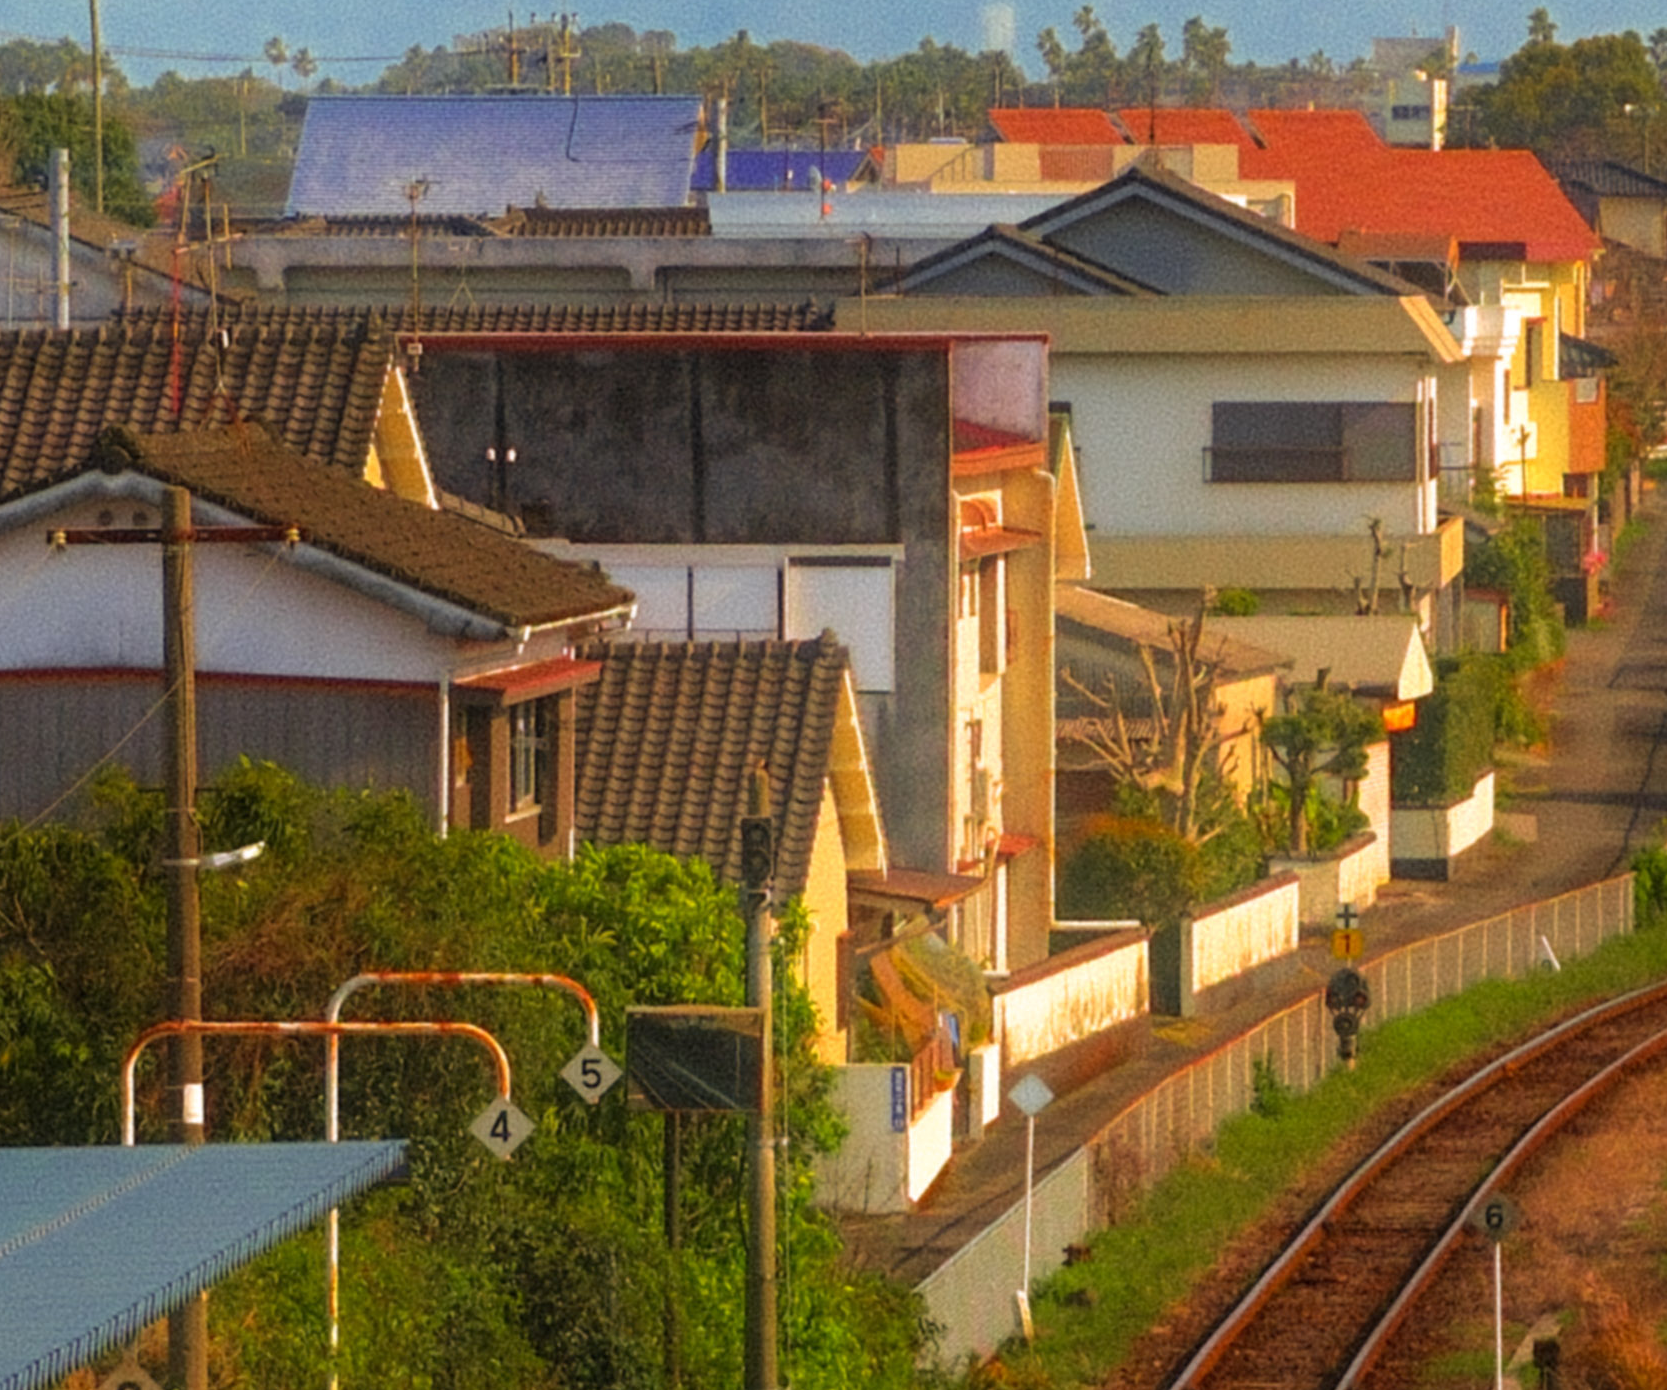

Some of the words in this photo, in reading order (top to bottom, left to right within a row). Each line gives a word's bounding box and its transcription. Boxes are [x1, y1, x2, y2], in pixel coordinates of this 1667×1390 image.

[582, 1058, 602, 1089] 5
[490, 1109, 512, 1142] 4
[1485, 1203, 1504, 1229] 6
